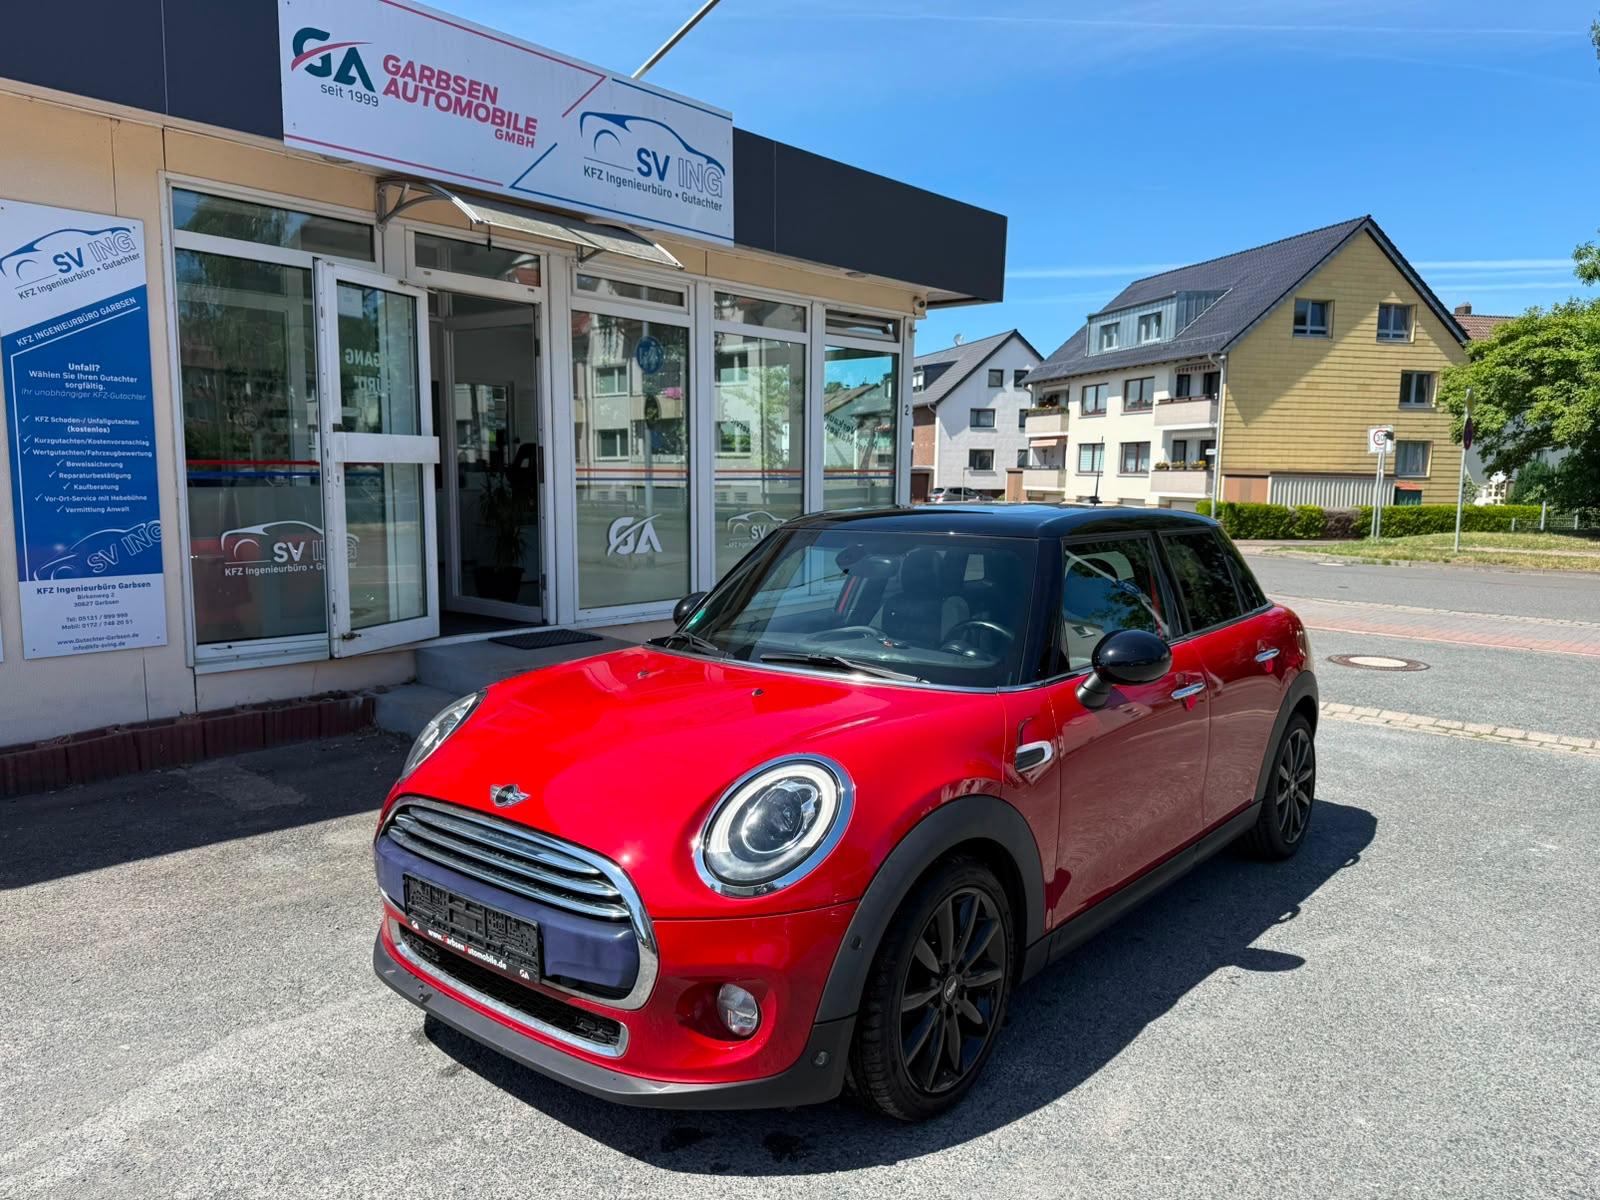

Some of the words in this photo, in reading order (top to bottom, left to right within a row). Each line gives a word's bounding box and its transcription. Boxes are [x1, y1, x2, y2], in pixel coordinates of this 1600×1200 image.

[383, 54, 498, 105] GARBSEN
[320, 84, 343, 98] seit
[348, 89, 379, 107] 1999
[383, 78, 537, 136] AUTOMOBILE
[495, 129, 535, 149] GMBH
[637, 147, 670, 182] SV
[678, 157, 723, 199] ING
[584, 165, 603, 181] KFZ
[606, 171, 673, 199] Ingenieurbüro
[681, 191, 723, 212] Gutachter
[53, 247, 84, 274] SV
[88, 231, 137, 262] ING
[18, 287, 37, 300] KFZ
[38, 268, 96, 293] Ingenieurbüro
[102, 252, 141, 271] Gutachter
[16, 334, 34, 347] KFZ
[34, 311, 100, 340] INGENIEURBÜRO
[99, 296, 137, 316] GARBSEN
[29, 370, 61, 379] Wählen
[62, 372, 76, 380] Sie
[77, 373, 99, 381] Ihren
[100, 374, 138, 383] Gutachter
[68, 362, 100, 372] Unfall?
[21, 387, 32, 395] Ihr
[65, 382, 106, 391] sorgfältig.
[904, 403, 910, 416] 2
[67, 425, 110, 434] (kostenlos)
[74, 483, 119, 491] Kaufberatung
[751, 525, 767, 540] SV
[87, 543, 119, 573] SV
[273, 541, 305, 563] SV
[225, 566, 243, 576] KFZ
[245, 563, 307, 577] Ingenieurbüro
[37, 587, 54, 595] KFZ
[56, 583, 117, 595] Ingenieurbüro
[118, 581, 151, 590] Garbsen
